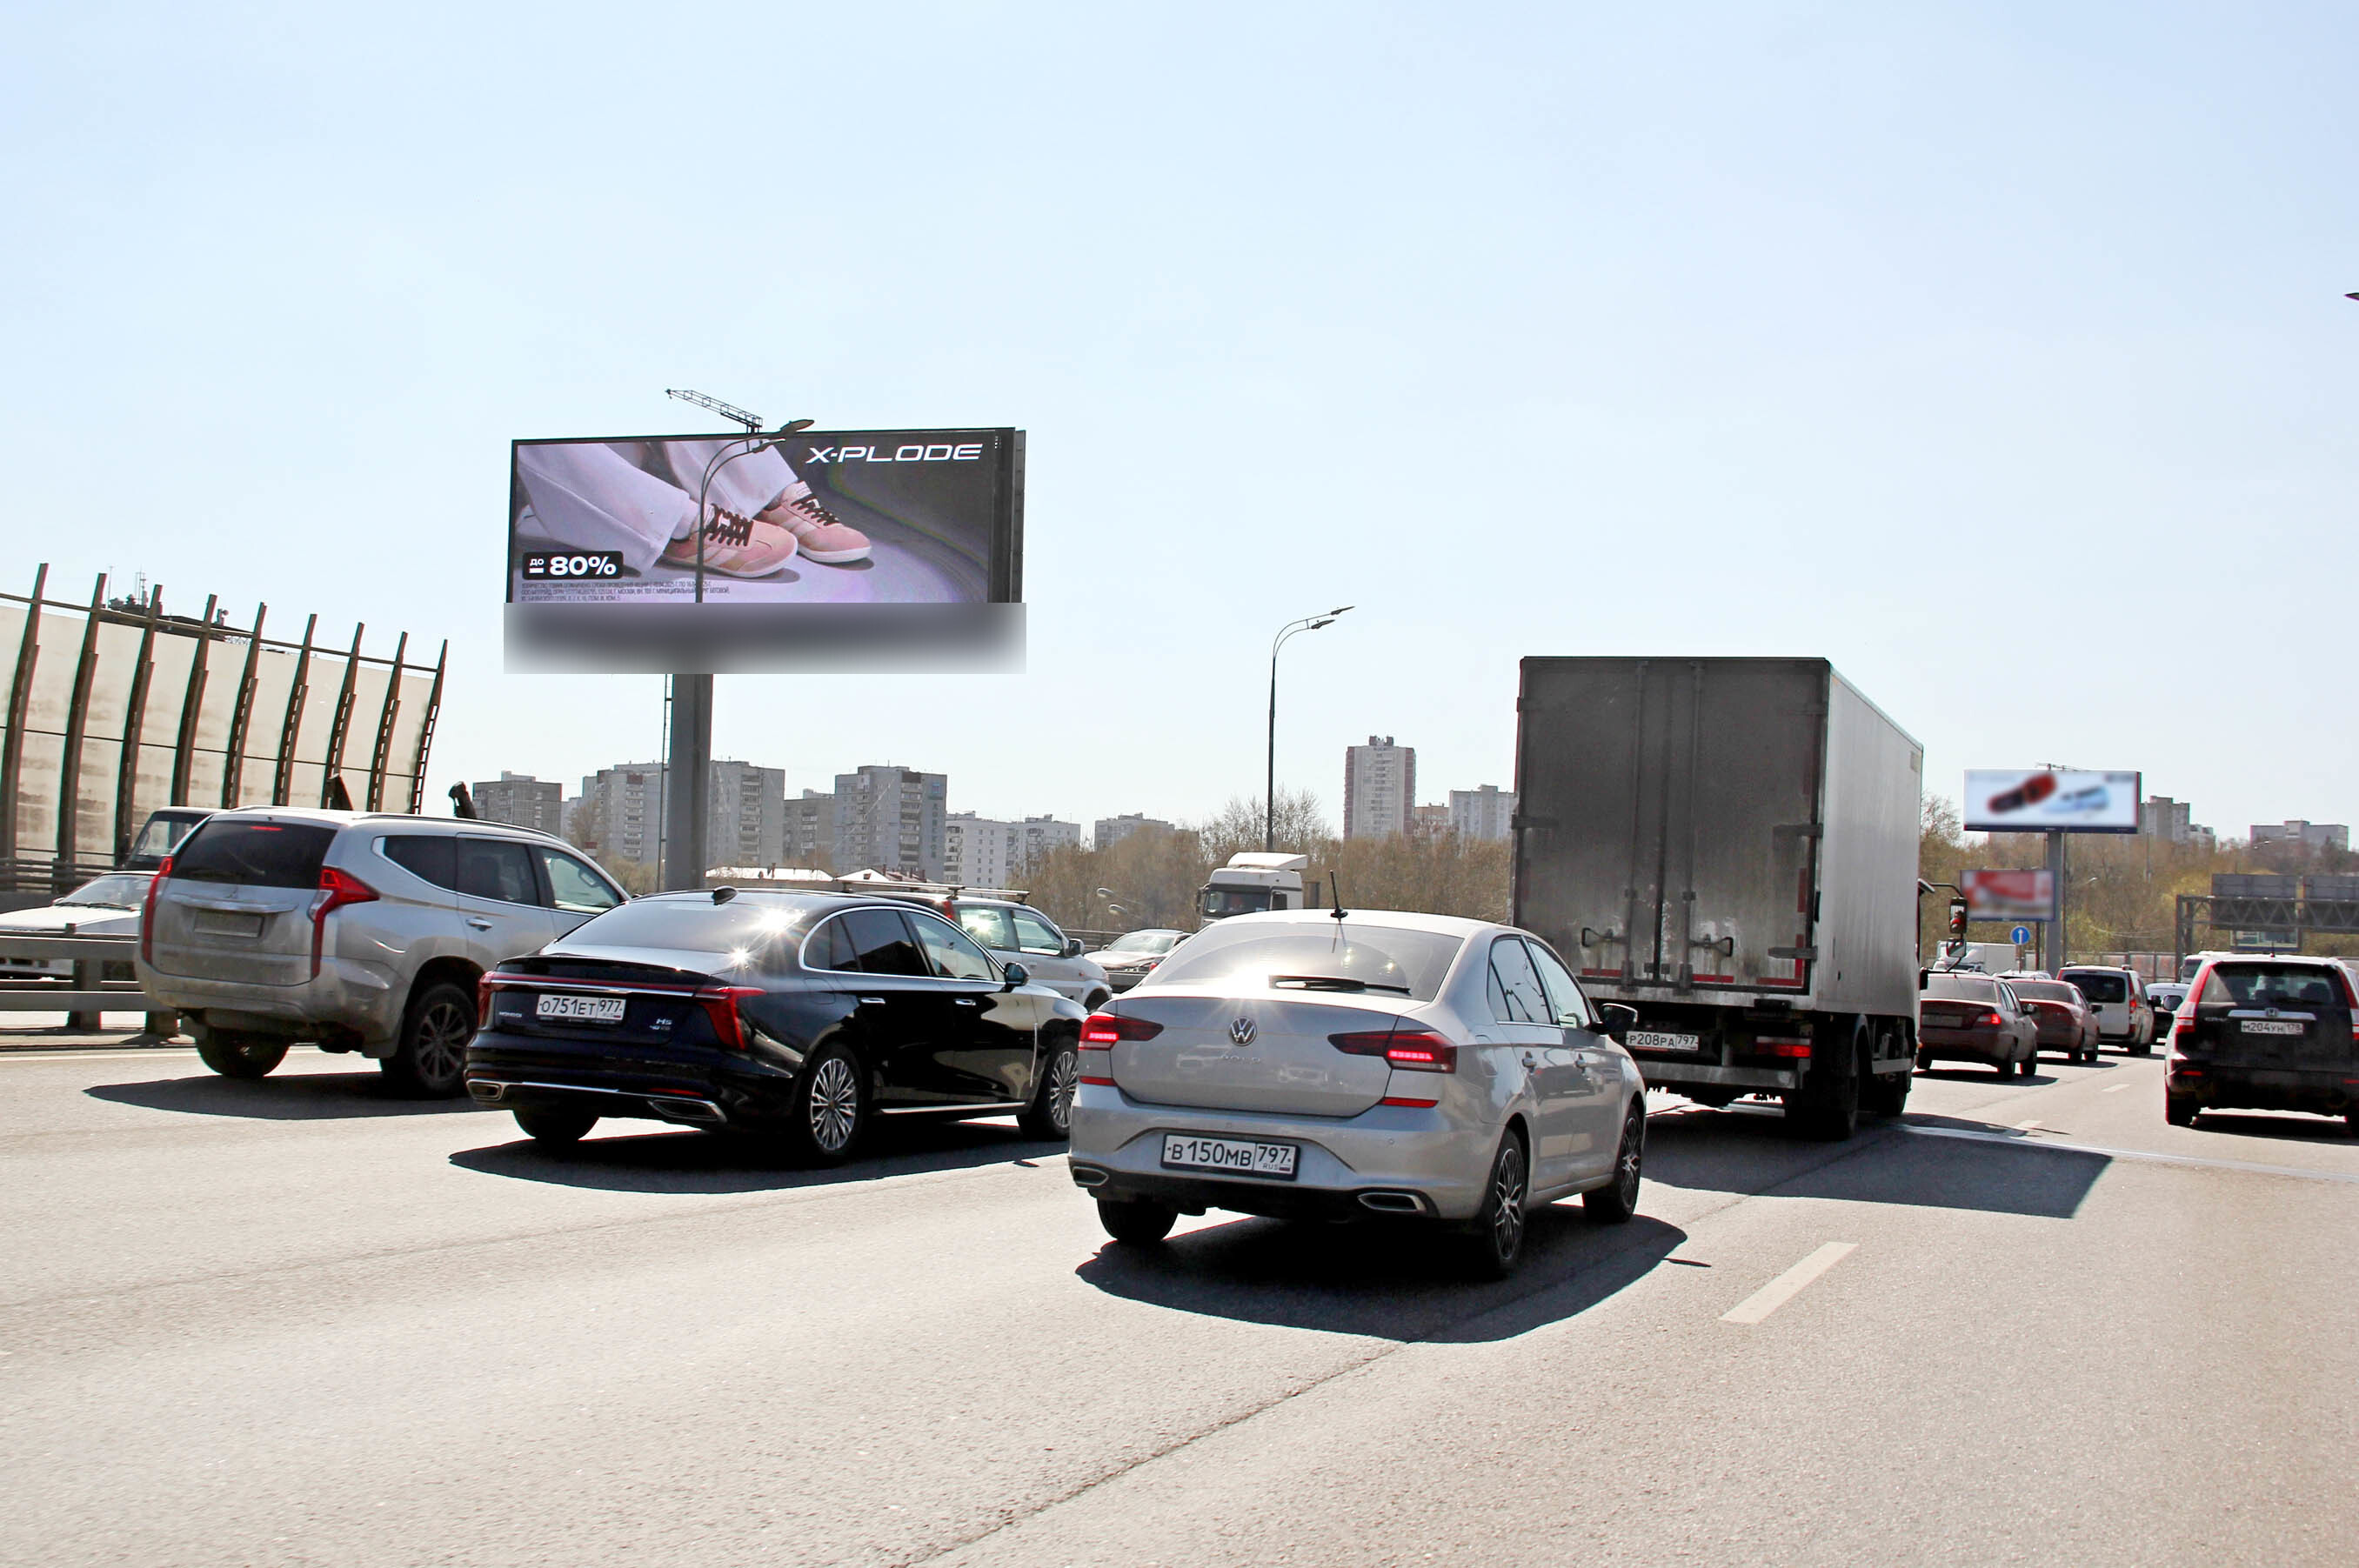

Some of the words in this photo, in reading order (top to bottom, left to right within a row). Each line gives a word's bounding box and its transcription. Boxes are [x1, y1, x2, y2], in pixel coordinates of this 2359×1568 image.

[805, 443, 984, 464] X-PLODE
[541, 998, 596, 1015] О751ЕТ
[599, 999, 622, 1013] 977
[1677, 1035, 1696, 1044] 797
[1172, 1141, 1253, 1166] В150МВ
[1258, 1146, 1289, 1164] 797
